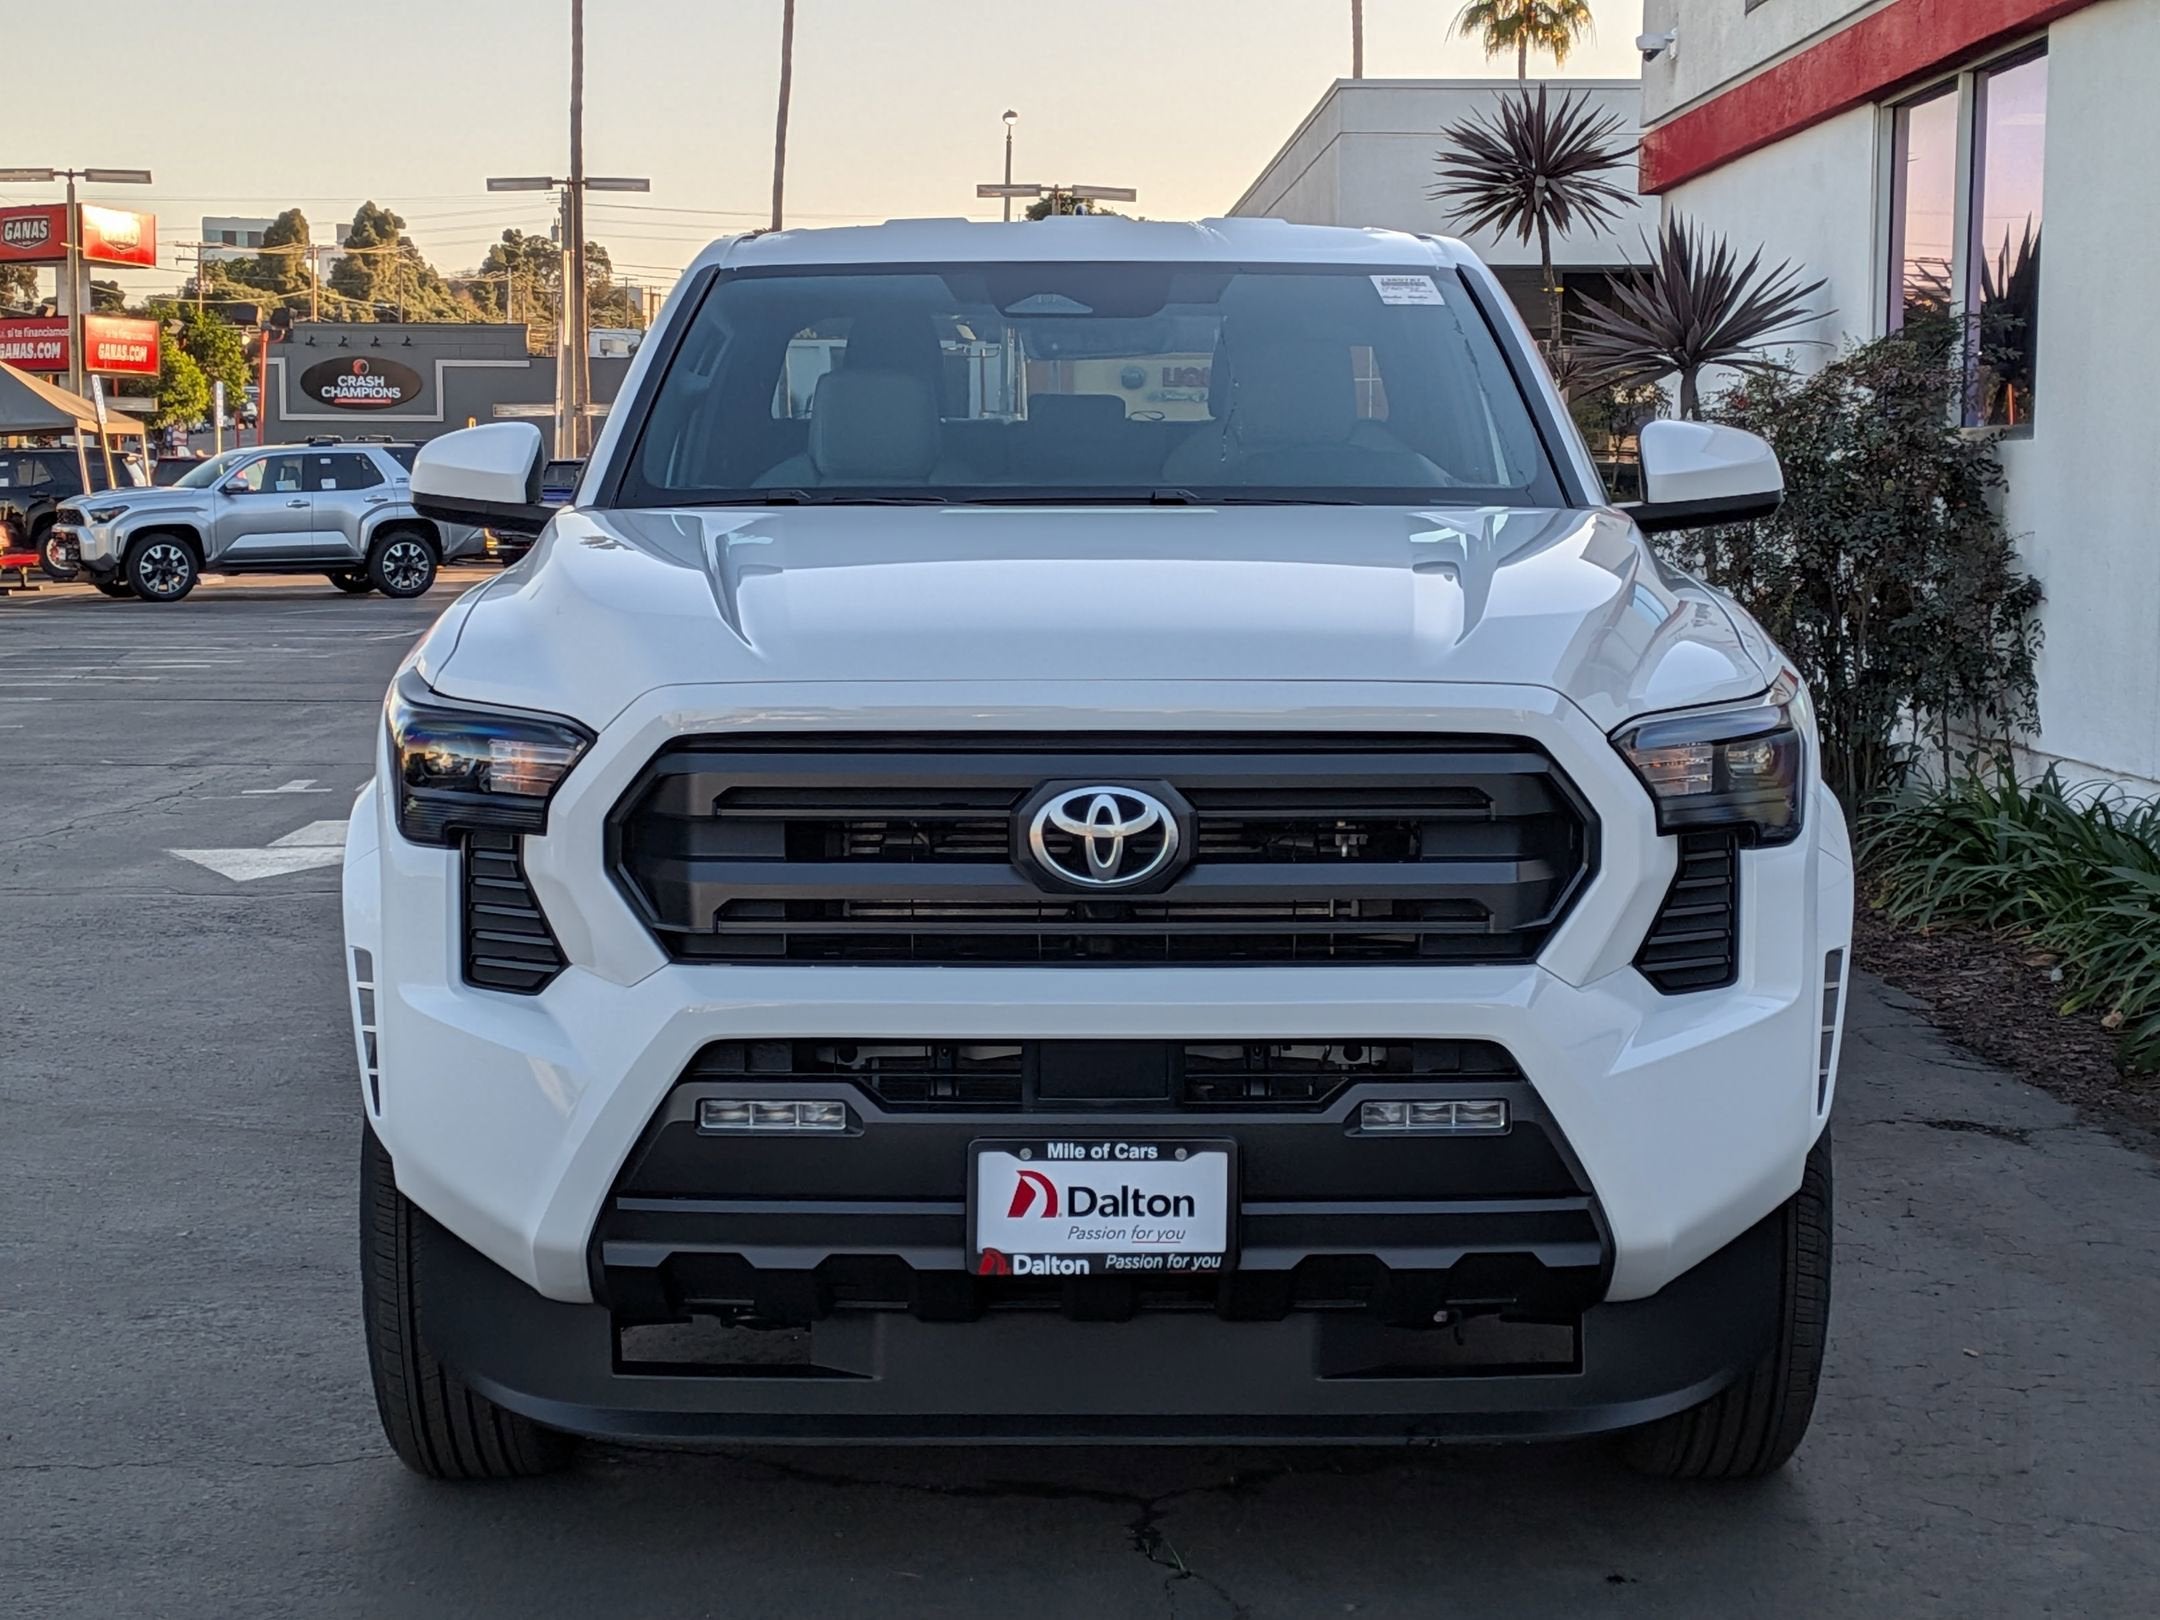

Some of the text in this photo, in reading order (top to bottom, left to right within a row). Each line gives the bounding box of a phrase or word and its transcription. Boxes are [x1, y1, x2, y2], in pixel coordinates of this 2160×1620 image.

[4, 220, 48, 240] GANAS
[97, 343, 148, 363] GANAS.COM
[337, 375, 385, 387] CRASH
[1047, 1142, 1158, 1160] Mile of Cars
[1067, 1185, 1195, 1218] Dalton
[1067, 1225, 1186, 1242] Passion for you
[1013, 1254, 1090, 1276] Dalton
[1105, 1253, 1222, 1271] Passion for you
